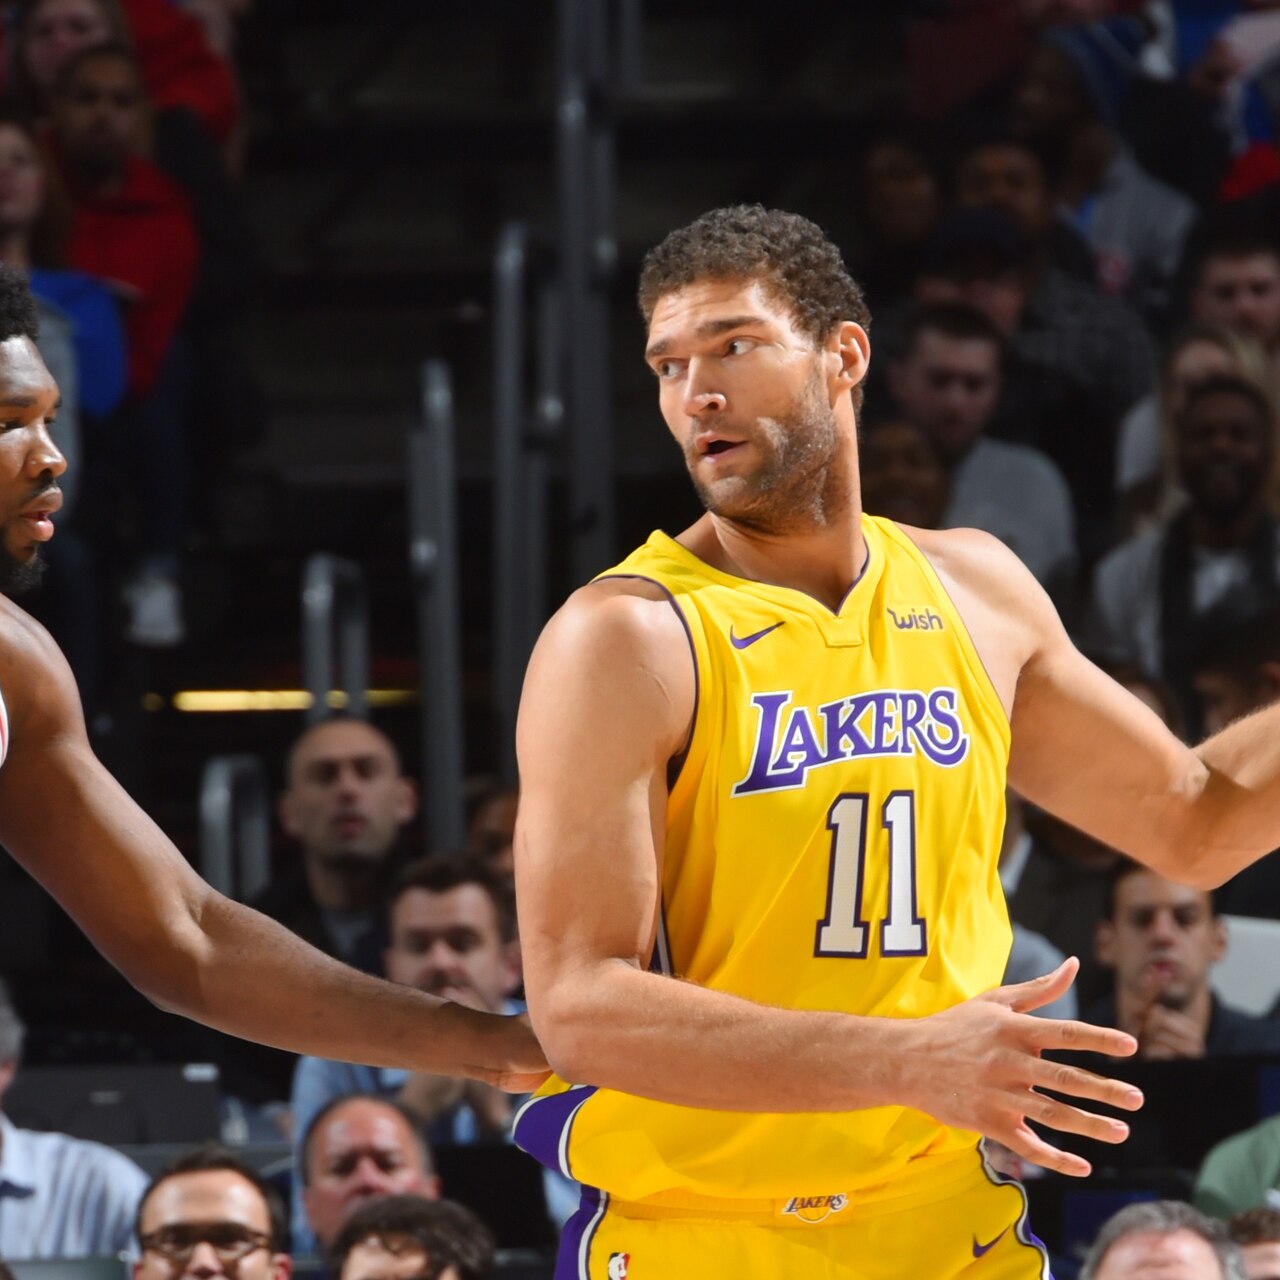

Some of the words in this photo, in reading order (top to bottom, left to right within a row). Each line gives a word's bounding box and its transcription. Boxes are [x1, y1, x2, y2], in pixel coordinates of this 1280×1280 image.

[887, 607, 945, 631] wish
[730, 687, 971, 799] LAKERS
[813, 789, 928, 960] 11
[781, 1192, 848, 1215] LAKERS
